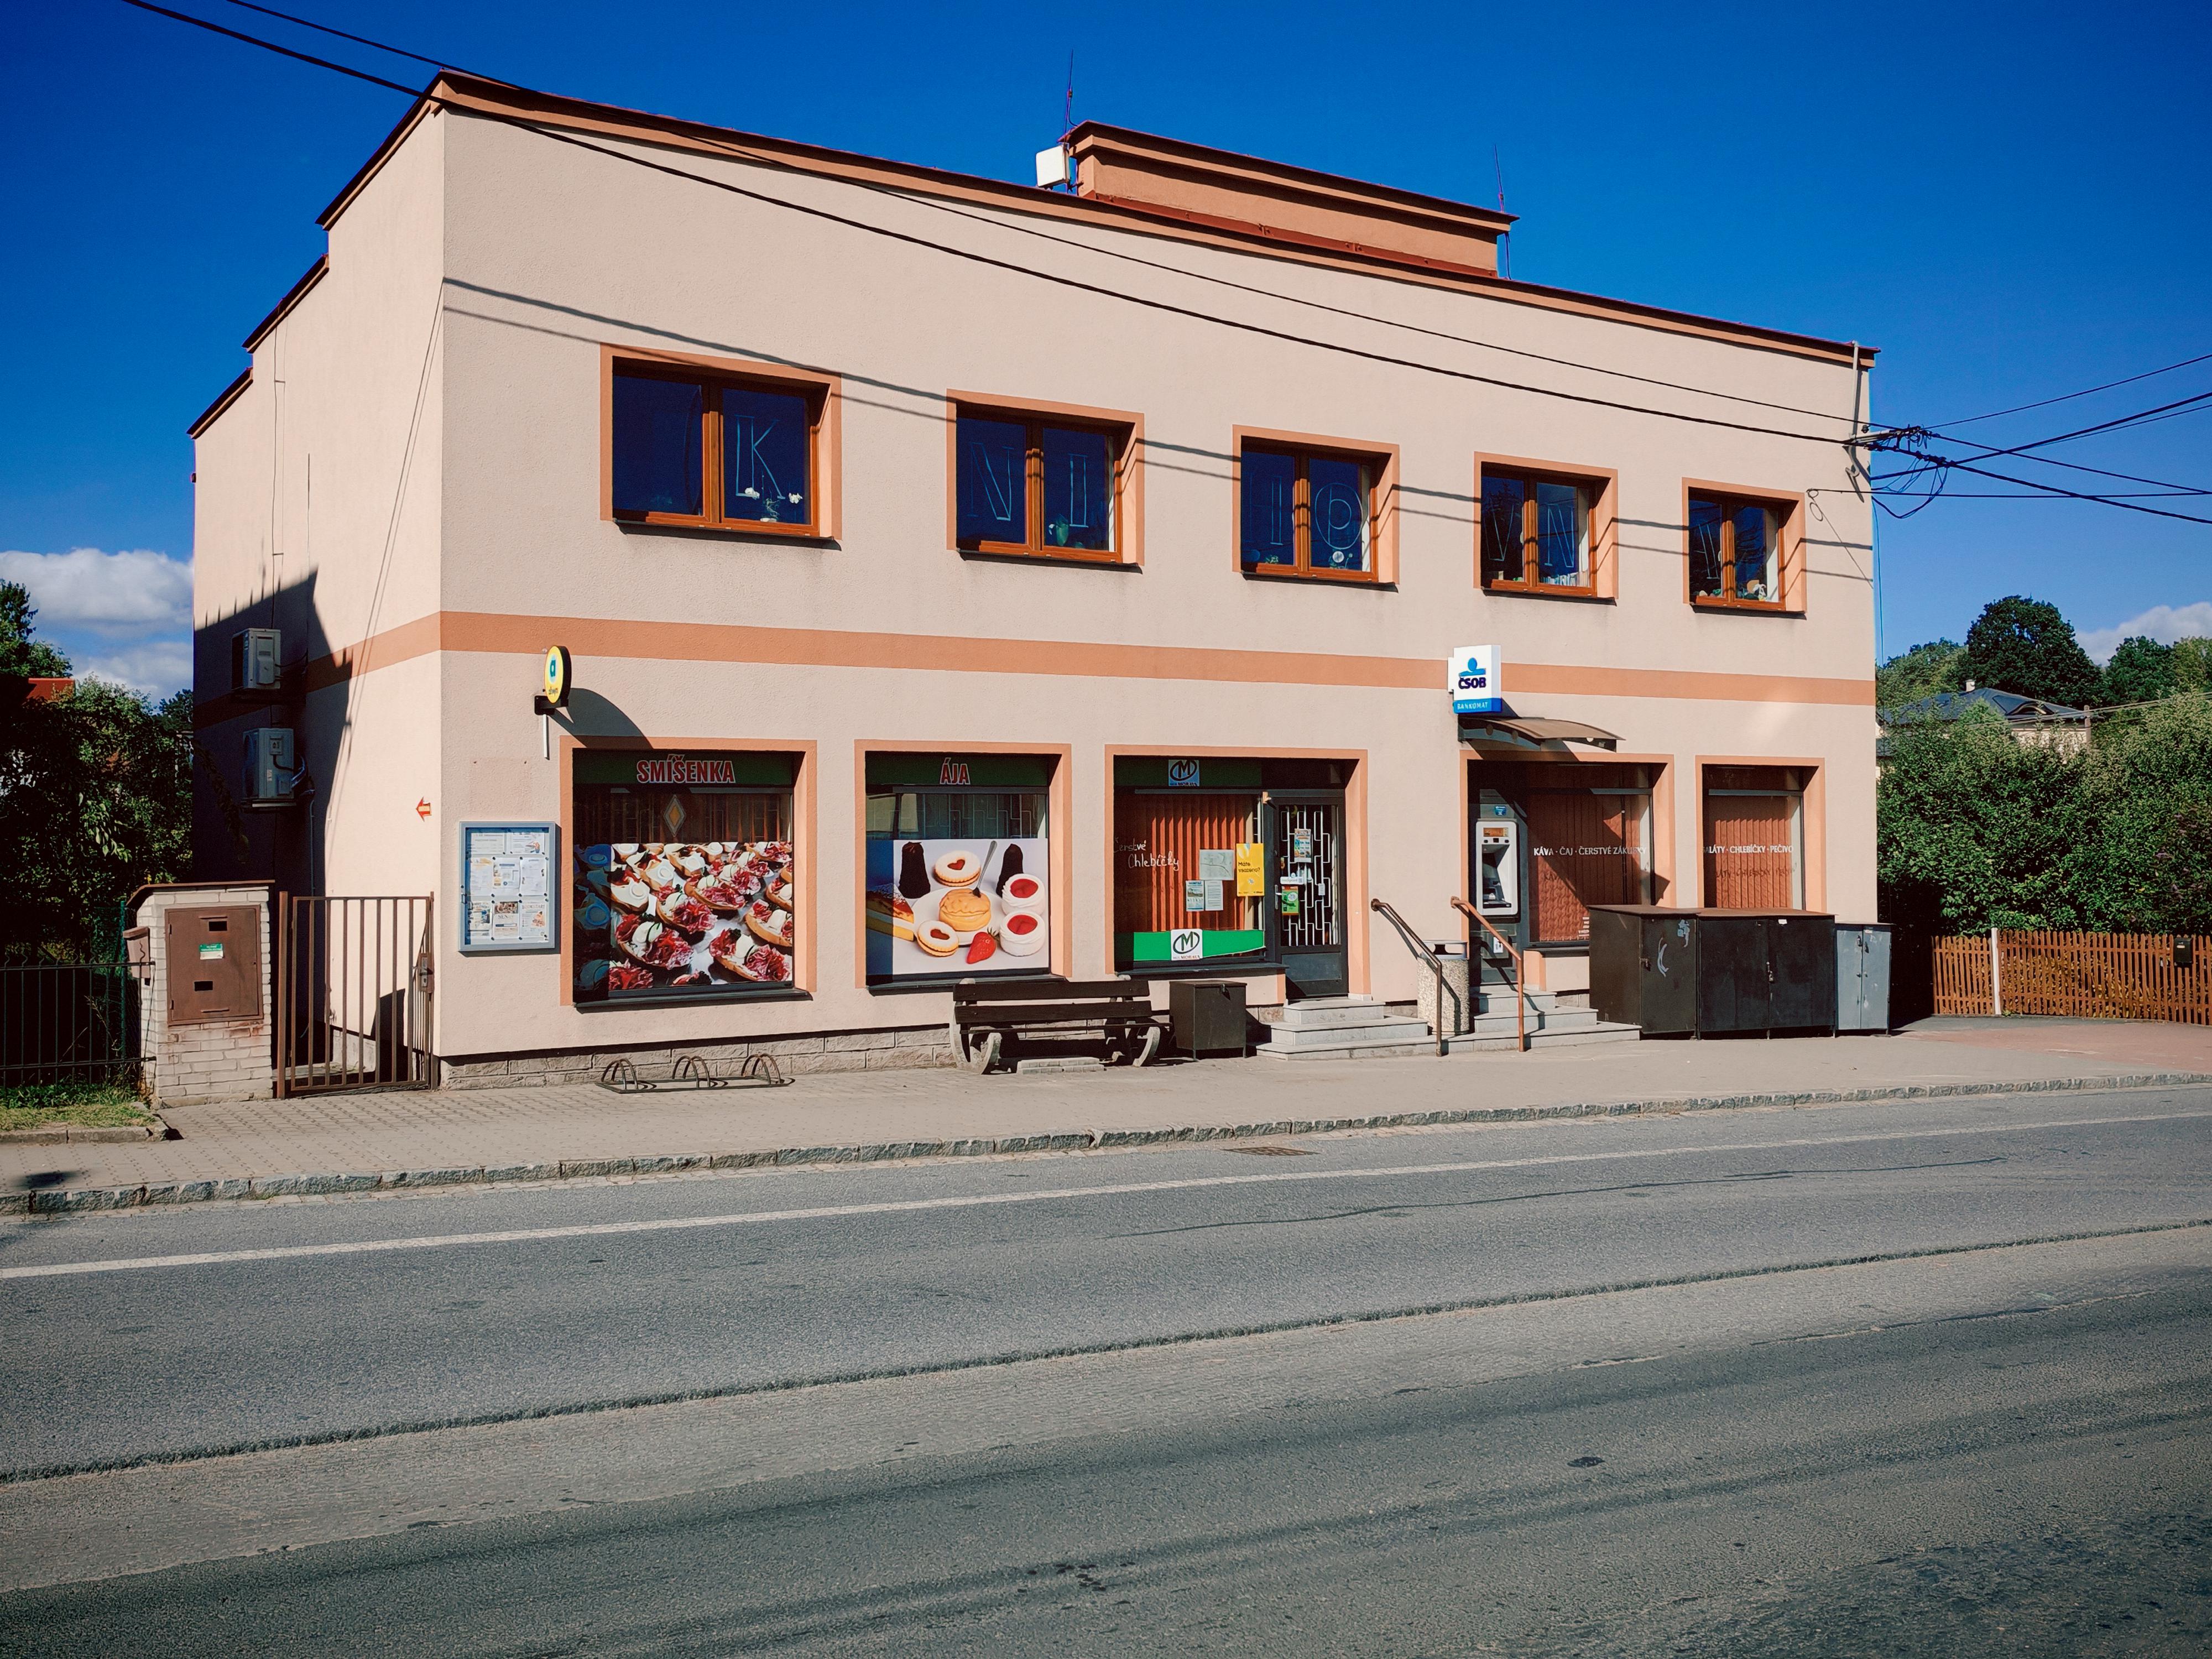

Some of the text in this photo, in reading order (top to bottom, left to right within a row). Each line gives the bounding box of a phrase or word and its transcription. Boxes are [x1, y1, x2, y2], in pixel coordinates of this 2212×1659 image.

[1458, 676, 1486, 690] ČSOB
[637, 754, 735, 784] SMÍŠENKA
[940, 758, 971, 785] ÁJA
[1533, 846, 1554, 855] KÁVA
[1559, 846, 1573, 855] ČAJ
[1578, 846, 1611, 855] ČERSTVÉ
[1729, 843, 1766, 853] CHLEBÍČKY
[1770, 844, 1794, 853] PEČIVO
[1128, 851, 1179, 872] Chlebíčky
